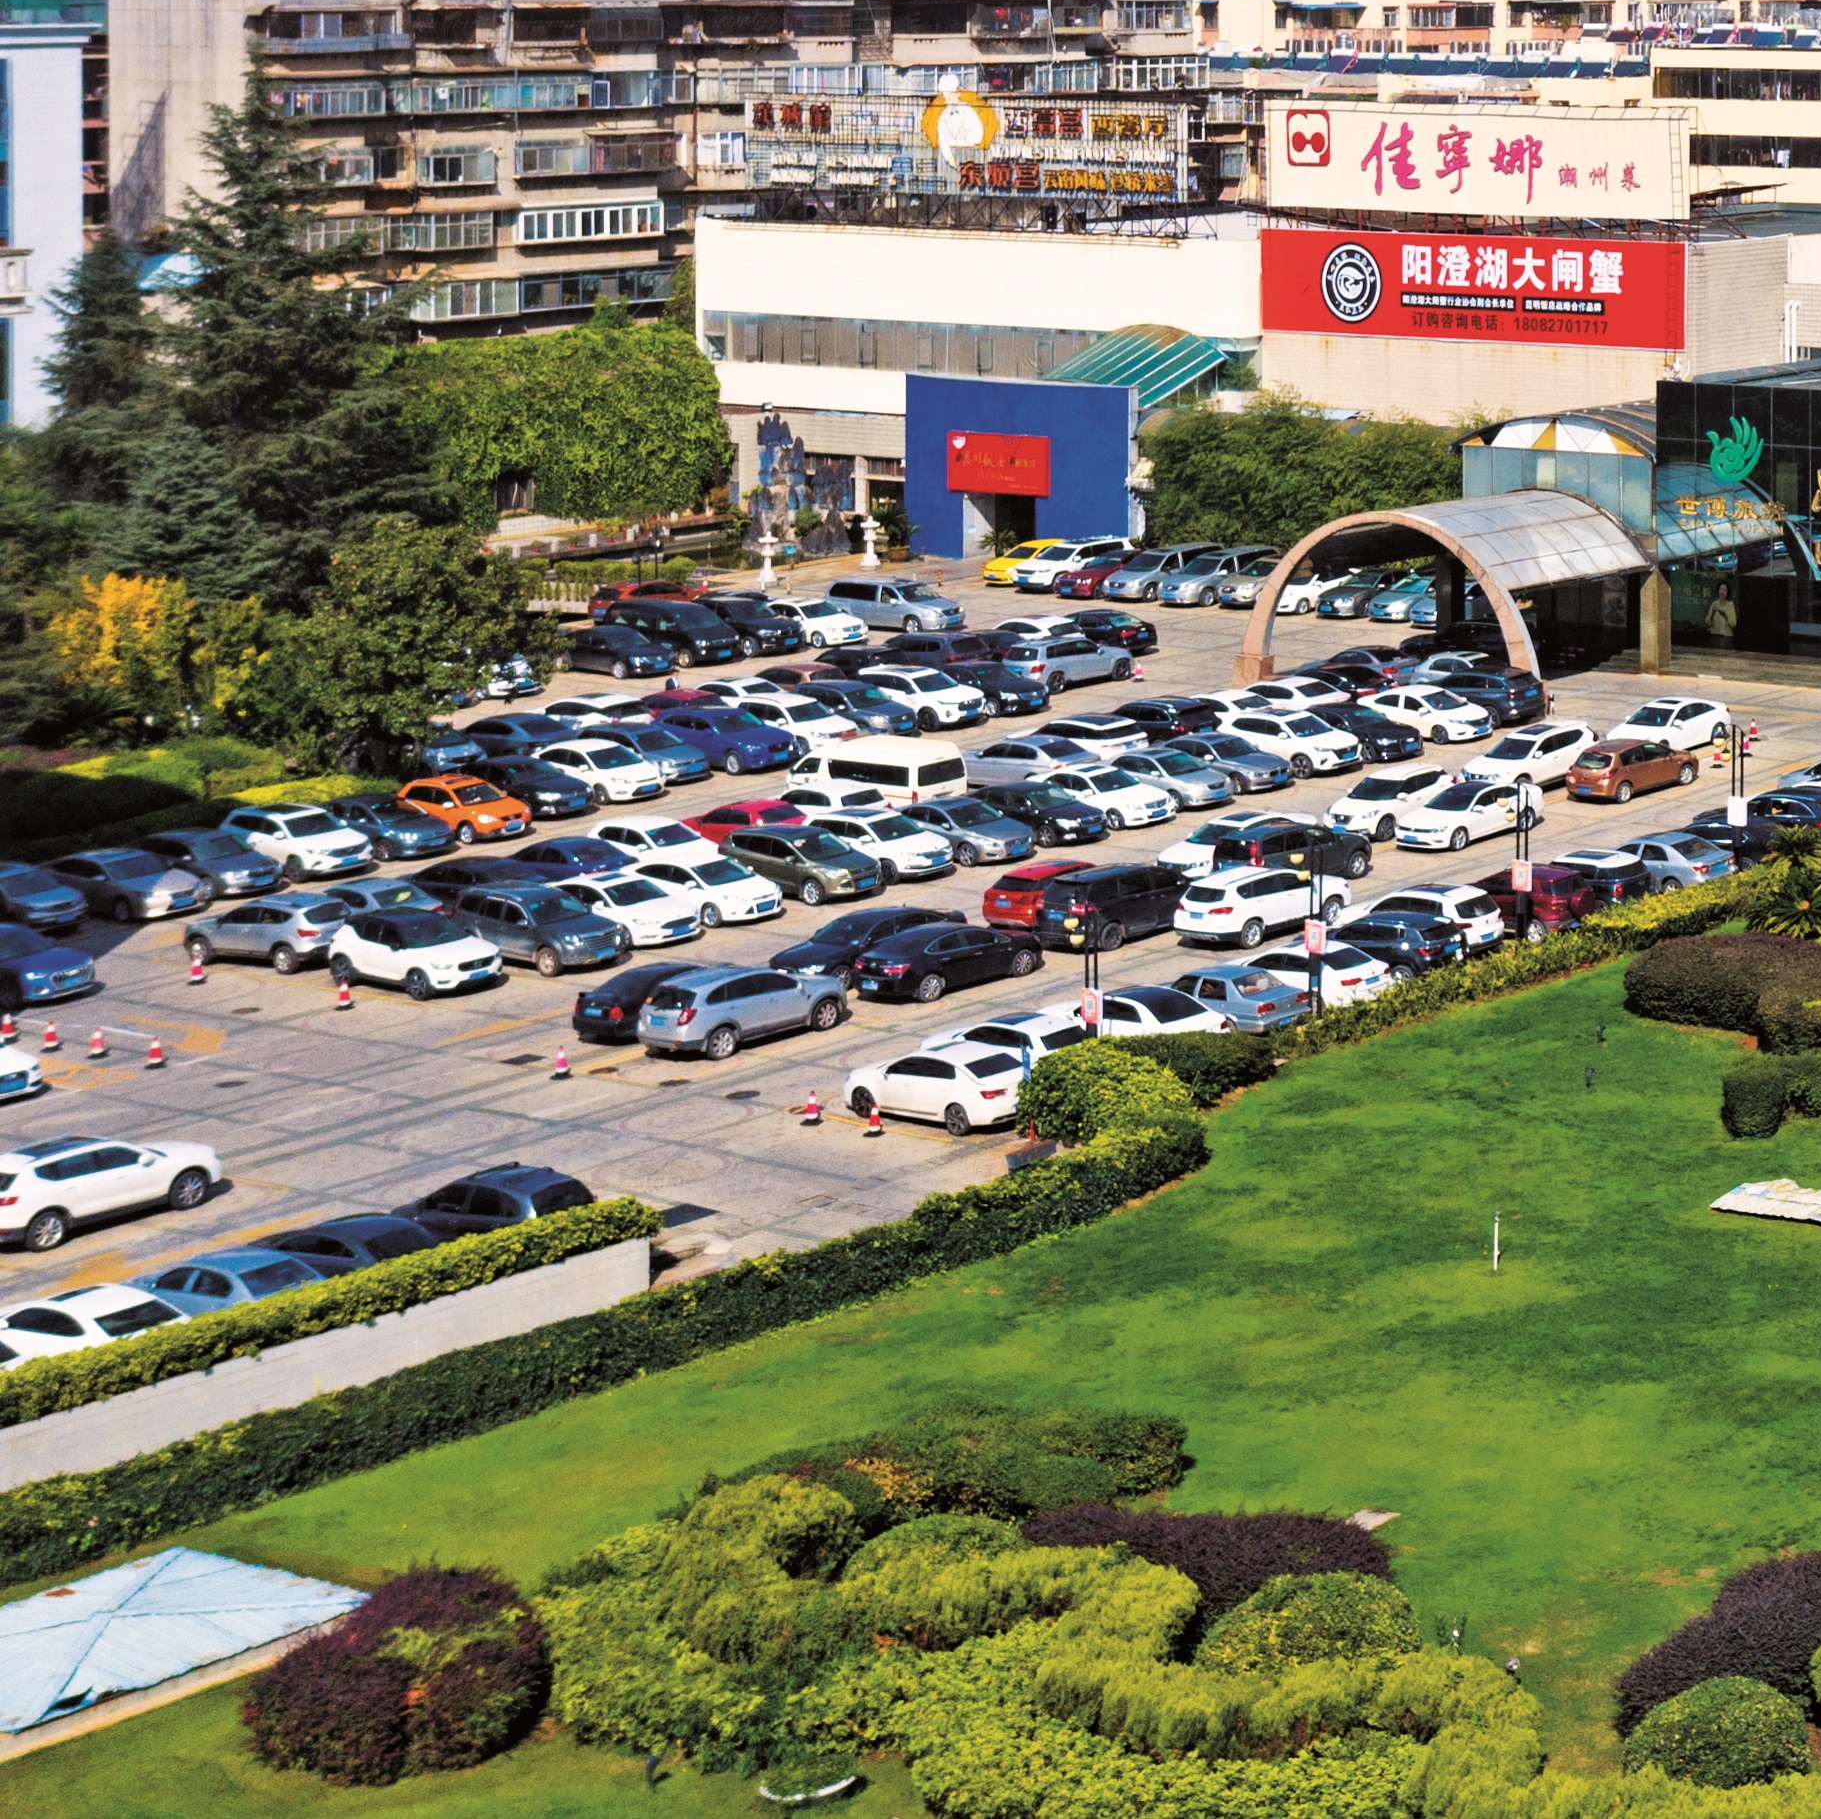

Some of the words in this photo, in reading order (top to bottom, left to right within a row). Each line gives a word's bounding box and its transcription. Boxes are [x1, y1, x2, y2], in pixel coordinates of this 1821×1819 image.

[1043, 168, 1107, 190] 云南风味
[1558, 161, 1641, 192] 潮州菜
[1401, 244, 1625, 295] 阳澄湖大闸蟹
[1402, 294, 1514, 310] 阳澄湖大闸蟹行业协会副会长单位
[1525, 299, 1602, 313] 昆明饭店战略合作品牌
[1514, 317, 1608, 335] 18082701717
[1676, 494, 1786, 522] 世博旅游
